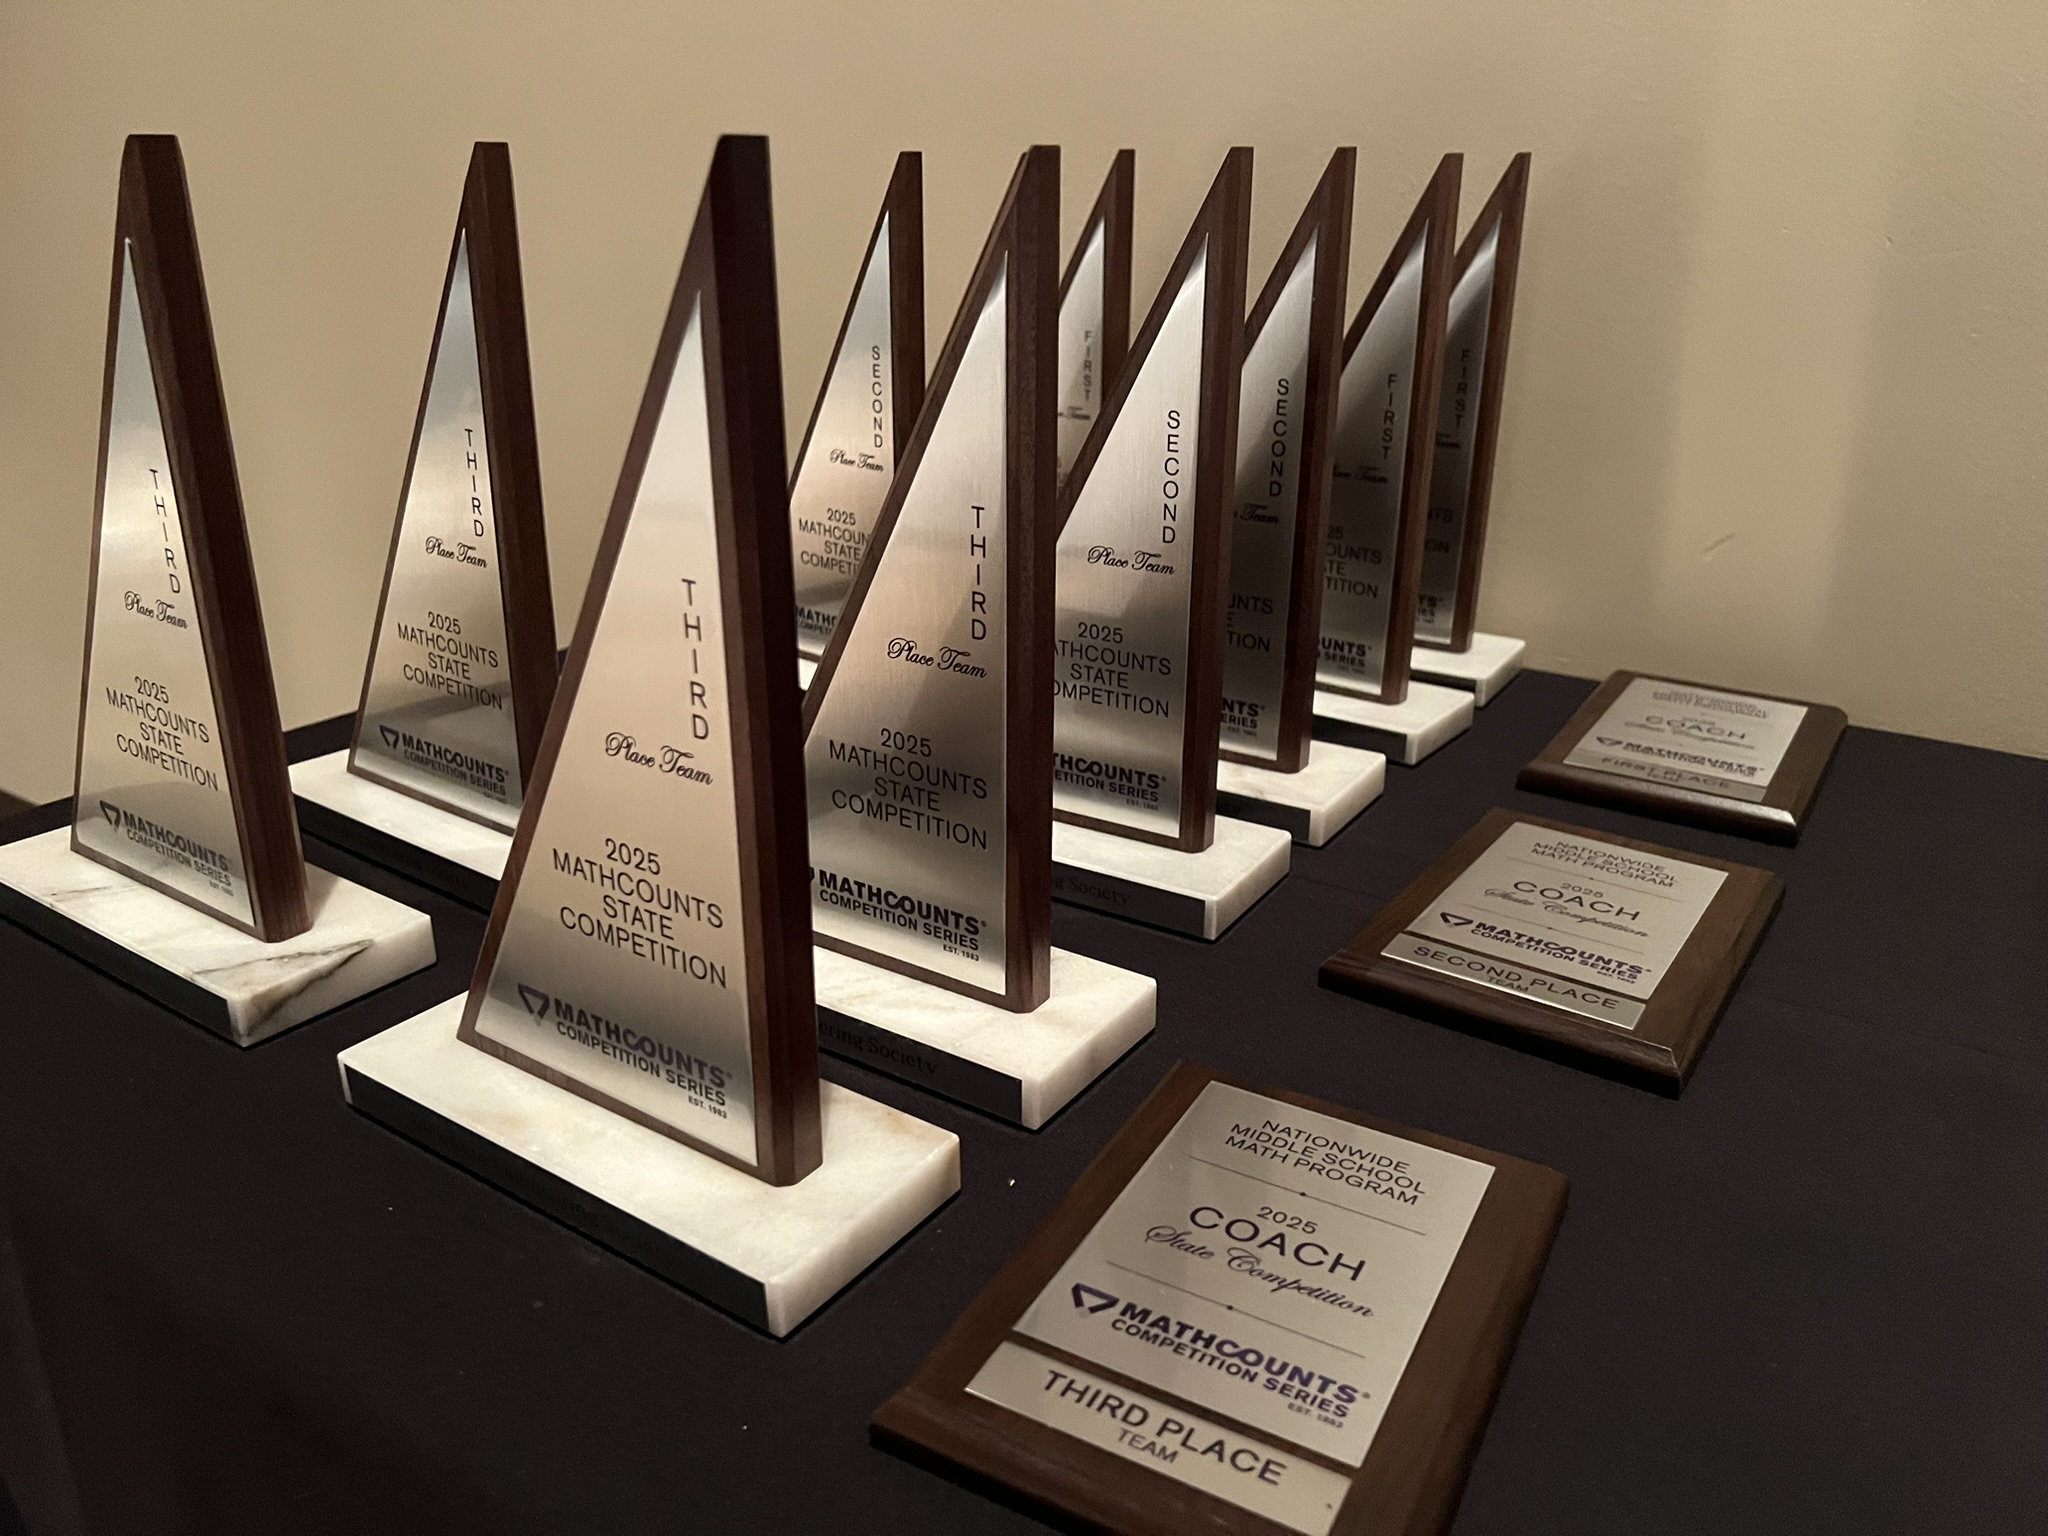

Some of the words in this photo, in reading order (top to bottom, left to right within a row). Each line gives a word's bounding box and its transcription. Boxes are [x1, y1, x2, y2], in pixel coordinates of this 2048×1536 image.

[871, 345, 884, 449] SECOND
[1382, 374, 1398, 460] FIRST
[1269, 378, 1290, 498] SECOND
[464, 429, 484, 537] THIRD
[857, 454, 884, 473] Team
[1162, 410, 1181, 544] SECOND
[149, 468, 181, 594] THIRD
[799, 518, 871, 546] MATHCOUN
[827, 508, 856, 526] 2025
[425, 536, 455, 561] Place
[456, 541, 488, 568] Team
[801, 550, 857, 576] COMPETI
[824, 540, 861, 561] STATE
[1087, 545, 1129, 570] Place
[1131, 550, 1175, 576] Team
[970, 504, 988, 642] THIRD
[1325, 576, 1378, 598] TITION
[124, 590, 155, 620] Place
[155, 599, 188, 630] Team
[428, 611, 462, 635] 2025
[397, 622, 499, 668] MATHCOUNTS
[1078, 622, 1124, 644] 2025
[428, 651, 471, 680] STATE
[681, 577, 709, 741] THIRD
[886, 637, 935, 669] Place
[936, 646, 987, 680] Team
[1054, 640, 1172, 676] THCOUNTS
[1070, 663, 1129, 689] STATE
[135, 676, 169, 705] 2025
[403, 663, 503, 710] COMPETITION
[1052, 680, 1170, 718] OMPETITION
[106, 686, 210, 744] MATHCOUNTS
[1646, 715, 1745, 739] COACH
[140, 721, 185, 756] STATE
[604, 730, 656, 769] Place
[658, 744, 714, 786] Team
[880, 728, 932, 759] 2025
[117, 733, 219, 792] COMPETITION
[404, 749, 467, 781] COMPETITION
[470, 772, 506, 795] SERIES
[828, 739, 988, 800] MATHCOUNTS
[1053, 752, 1160, 789] THCOUNTS
[874, 777, 942, 812] STATE
[1055, 770, 1104, 789] ETITION
[1109, 782, 1159, 802] SERIES
[831, 788, 988, 851] COMPETITION
[127, 829, 192, 868] COMPETITION
[194, 860, 231, 887] SERIES
[604, 837, 661, 876] 2025
[1531, 848, 1578, 864] MATH
[1582, 861, 1674, 888] PROGRAM
[1534, 842, 1600, 863] MIDDLE
[1602, 858, 1679, 882] SCHOOL
[1557, 841, 1666, 872] NATIONWIDE
[552, 847, 724, 930] MATHCOUNTS
[1513, 880, 1641, 921] COACH
[603, 893, 674, 941] STATE
[820, 889, 918, 932] COMPETITION
[923, 922, 979, 951] SERIES
[559, 905, 727, 989] COMPETITION
[1471, 929, 1575, 962] COMPETITION
[1578, 959, 1638, 980] SERIES
[1414, 946, 1522, 983] SECOND
[1529, 978, 1620, 1010] PLACE
[1487, 975, 1530, 993] TEAM
[557, 1021, 661, 1078] COMPETITION
[666, 1069, 726, 1106] SERIES
[1230, 1123, 1319, 1159] MIDDLE
[1321, 1152, 1425, 1195] SCHOOL
[1262, 1120, 1410, 1174] NATIONWIDE
[1225, 1135, 1289, 1164] MATH
[1293, 1157, 1419, 1206] PROGRAM
[1256, 1205, 1318, 1235] 2025
[1189, 1204, 1367, 1282] COACH
[1144, 1224, 1215, 1261] State
[1226, 1245, 1375, 1319] Competition
[1111, 1318, 1259, 1383] COMPETITION
[1263, 1377, 1351, 1419] SERIES
[1043, 1369, 1150, 1430] THIRD
[1155, 1415, 1288, 1487] PLACE
[1116, 1426, 1178, 1464] TEAM
